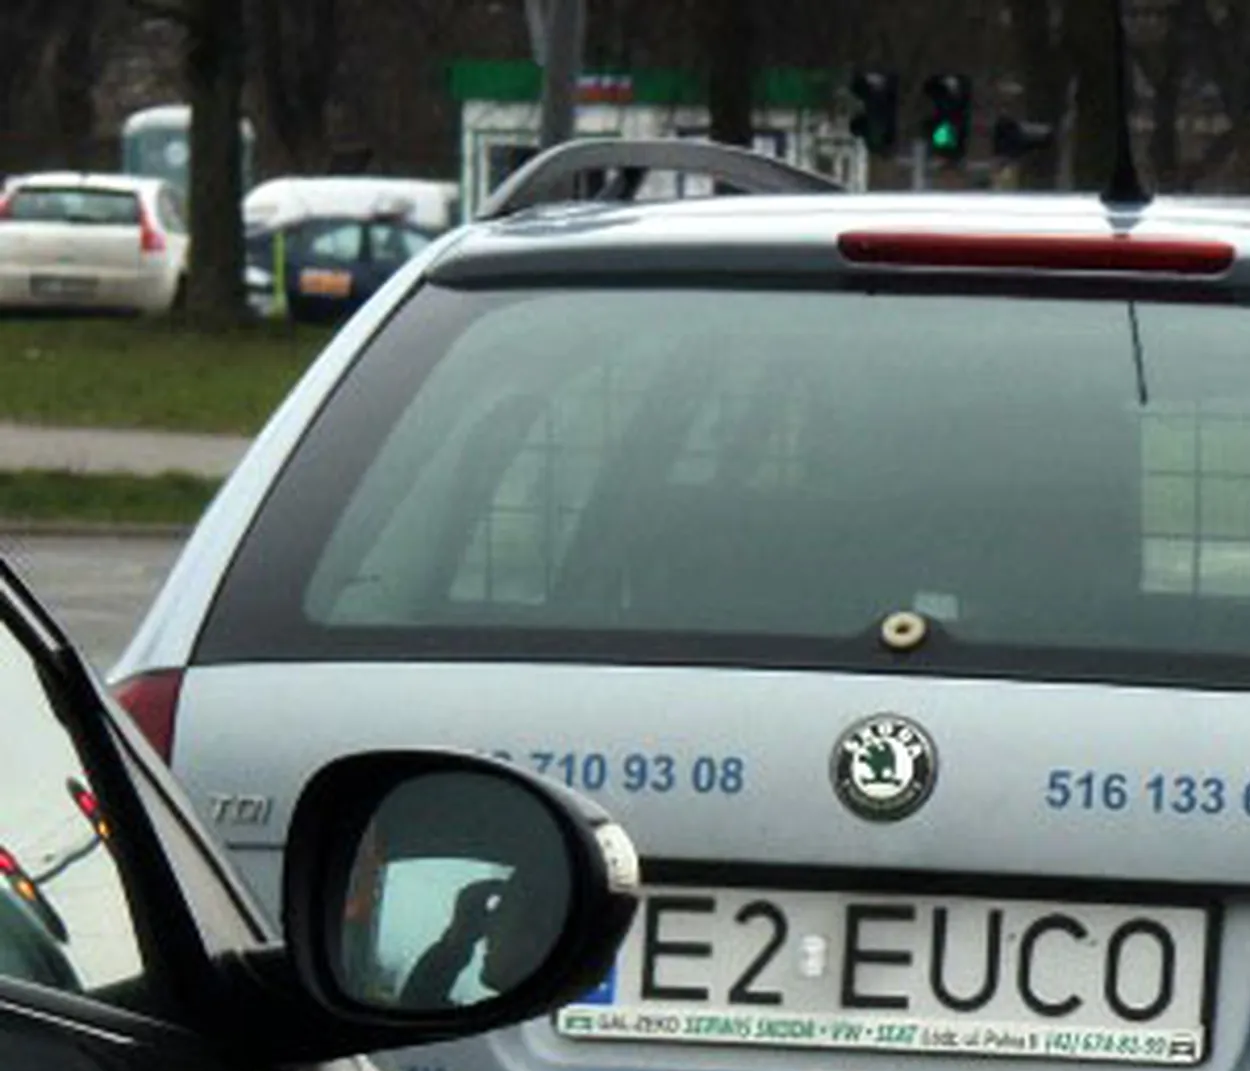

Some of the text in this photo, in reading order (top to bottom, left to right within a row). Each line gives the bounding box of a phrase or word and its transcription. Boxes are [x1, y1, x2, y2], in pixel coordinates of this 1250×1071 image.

[622, 753, 675, 792] 93
[692, 756, 744, 794] 08
[1045, 769, 1127, 810] 516
[1146, 773, 1225, 814] 133
[640, 895, 1176, 1022] E2 EUCO
